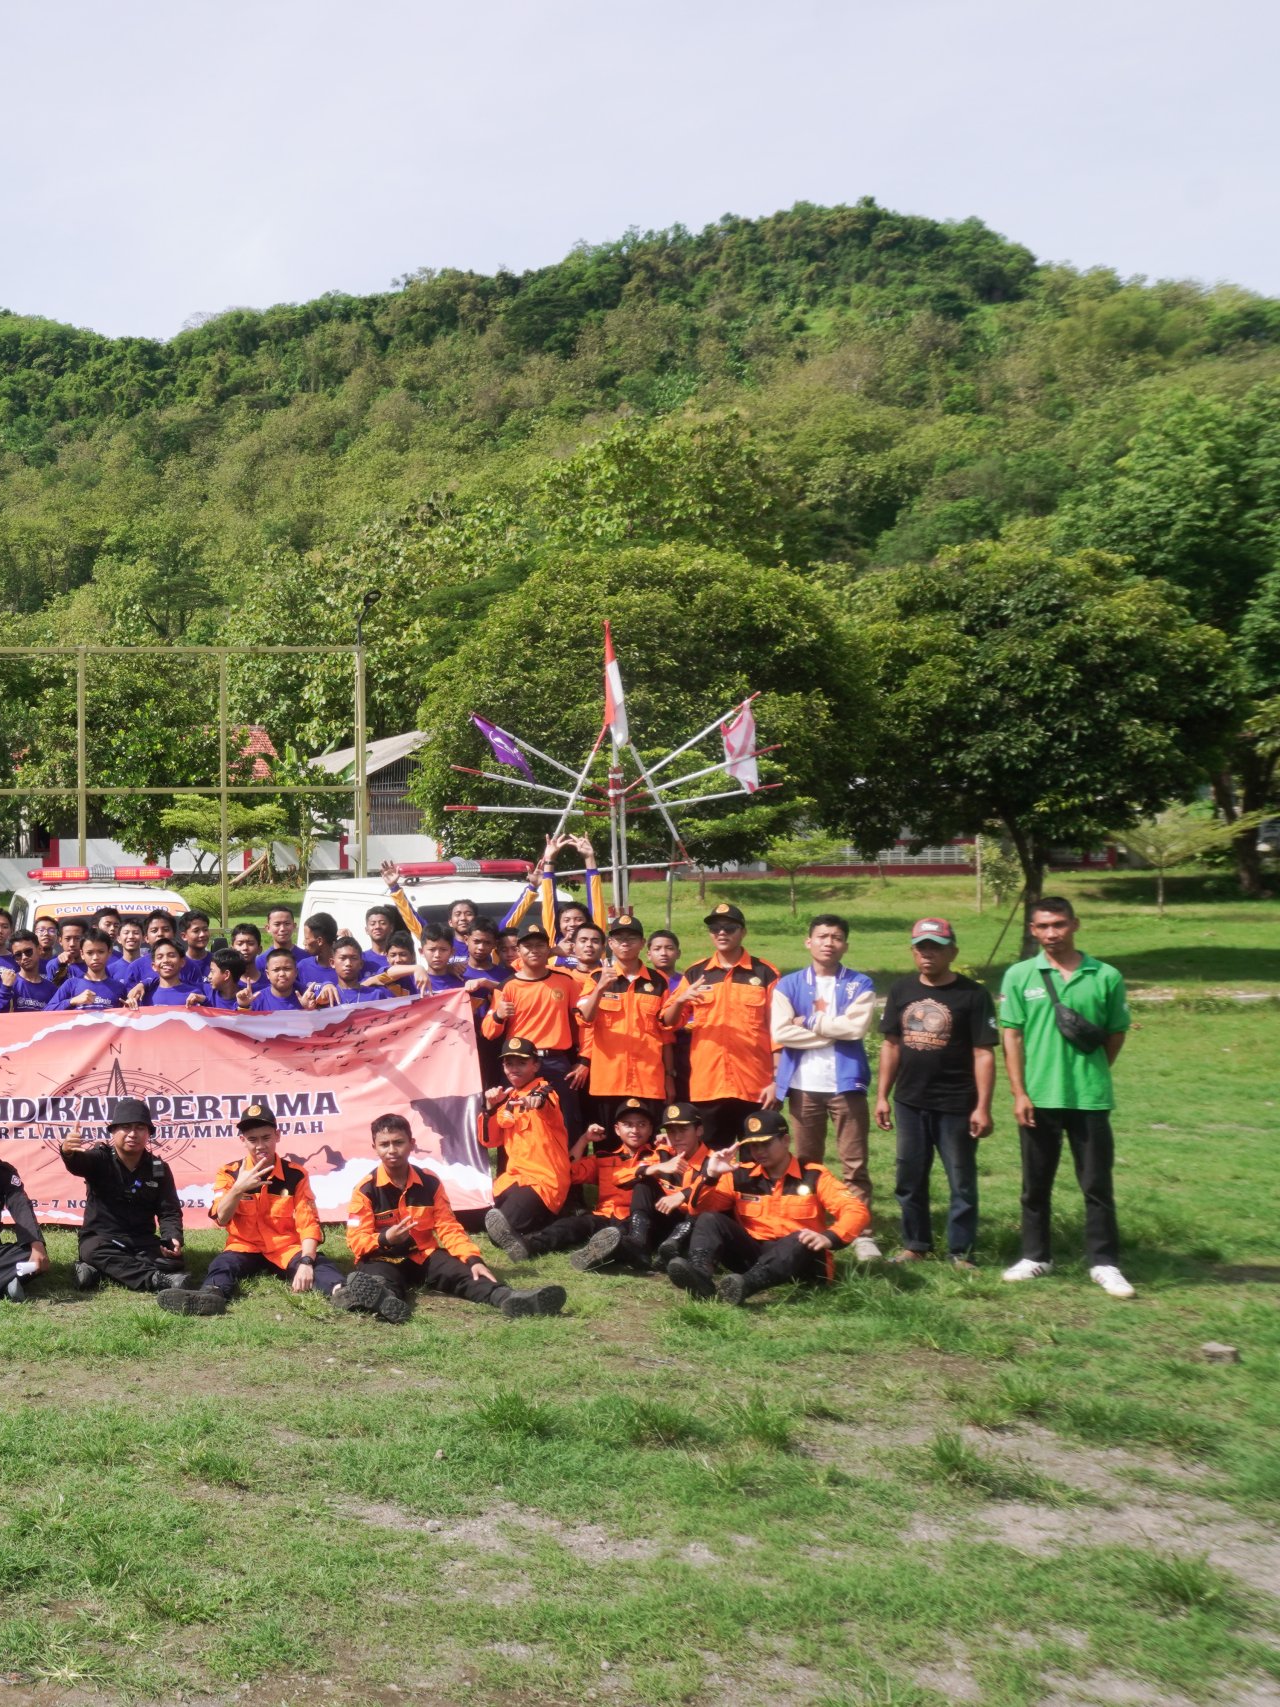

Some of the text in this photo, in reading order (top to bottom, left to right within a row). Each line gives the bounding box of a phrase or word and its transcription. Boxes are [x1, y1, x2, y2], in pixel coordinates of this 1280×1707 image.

[56, 906, 82, 914] PCM
[109, 1042, 122, 1055] N
[179, 1199, 205, 1208] 025
